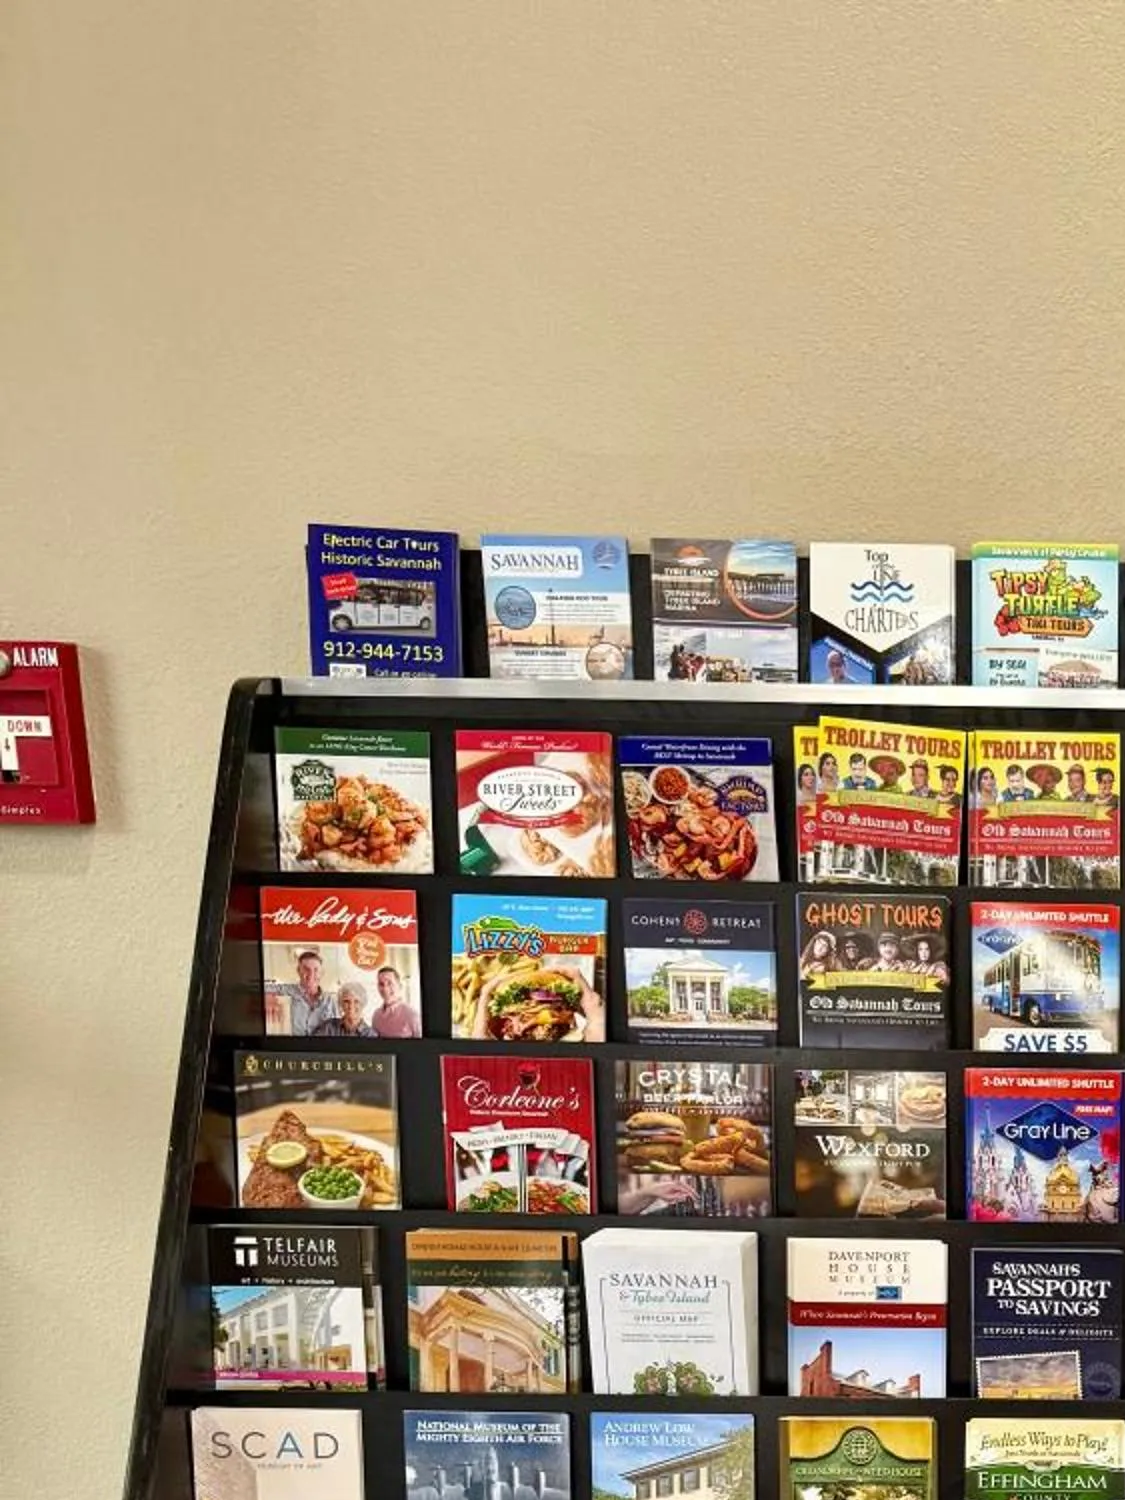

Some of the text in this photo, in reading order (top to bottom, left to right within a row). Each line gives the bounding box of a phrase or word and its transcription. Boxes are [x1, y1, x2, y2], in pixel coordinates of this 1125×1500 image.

[324, 533, 439, 552] Electric Car Tours
[321, 552, 442, 571] Historic Savannah
[491, 553, 579, 571] SAVANNAH
[13, 647, 59, 667] ALARM
[324, 641, 443, 662] 912-944-7153
[7, 720, 42, 732] DOWN
[824, 726, 961, 758] TROLLEY TOURS
[483, 784, 576, 797] RIVER STREET
[822, 808, 950, 835] Old Savannah Tours
[806, 903, 942, 928] GHOST TOURS
[1004, 1033, 1087, 1051] SAVE $5
[264, 1061, 383, 1072] CHURCHILL'S
[639, 1071, 748, 1090] CRYSTAL
[458, 1077, 580, 1112] Corleone's
[816, 1135, 930, 1157] WEXFORD
[264, 1238, 336, 1252] TELFAIR
[267, 1255, 338, 1266] MUSEUMS
[829, 1251, 910, 1262] DAVENPORT
[609, 1273, 718, 1289] SAVANNAH
[987, 1278, 1111, 1299] PASSPORT
[211, 1432, 338, 1459] SCAD
[979, 1471, 1108, 1488] EFFINGHAM
